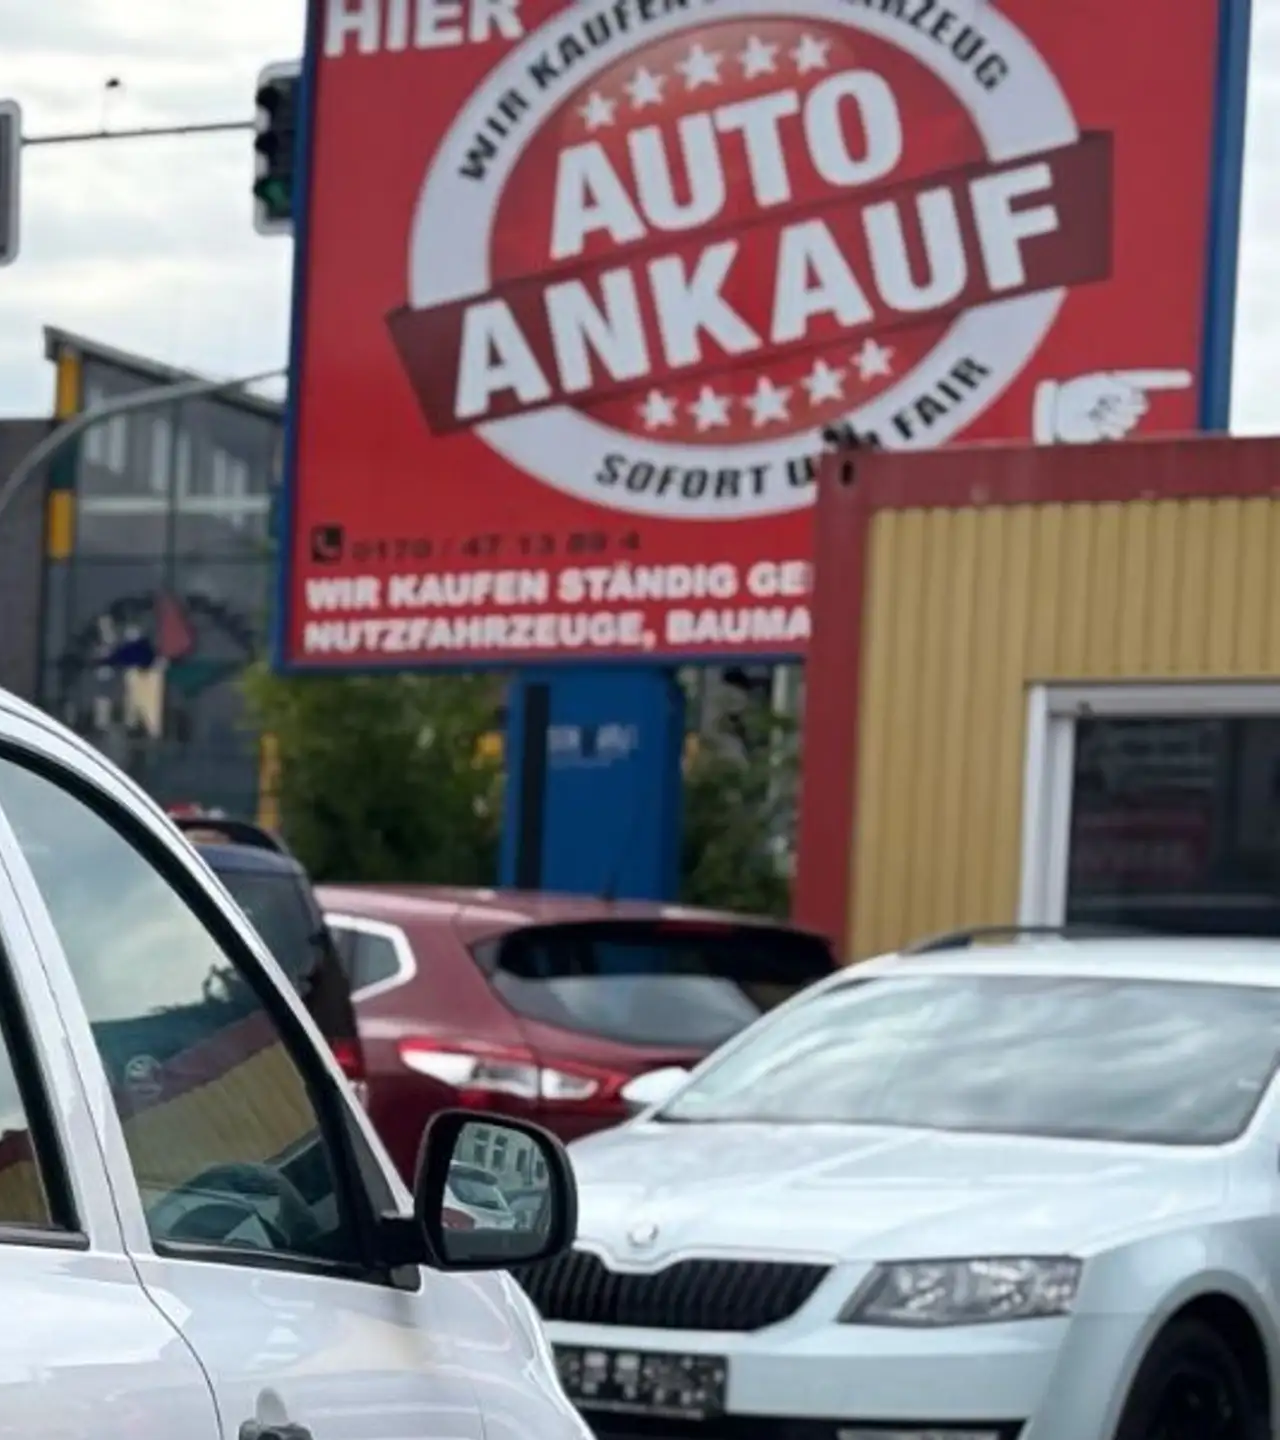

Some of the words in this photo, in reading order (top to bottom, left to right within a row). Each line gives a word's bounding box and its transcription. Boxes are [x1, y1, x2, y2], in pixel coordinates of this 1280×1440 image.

[324, 0, 524, 58] HIER
[458, 88, 531, 182] WIR
[548, 68, 904, 260] AUTO
[454, 164, 1060, 419] ANKAUF
[595, 453, 771, 499] SOFORT
[890, 355, 992, 442] FAIR
[303, 609, 657, 653] NUTZFAHRZEUGE,
[665, 605, 812, 645] BAUMA
[305, 574, 382, 612] WIR
[388, 568, 549, 608] KAUFEN
[557, 559, 739, 603] STÄNDIG
[746, 558, 814, 598] GE
